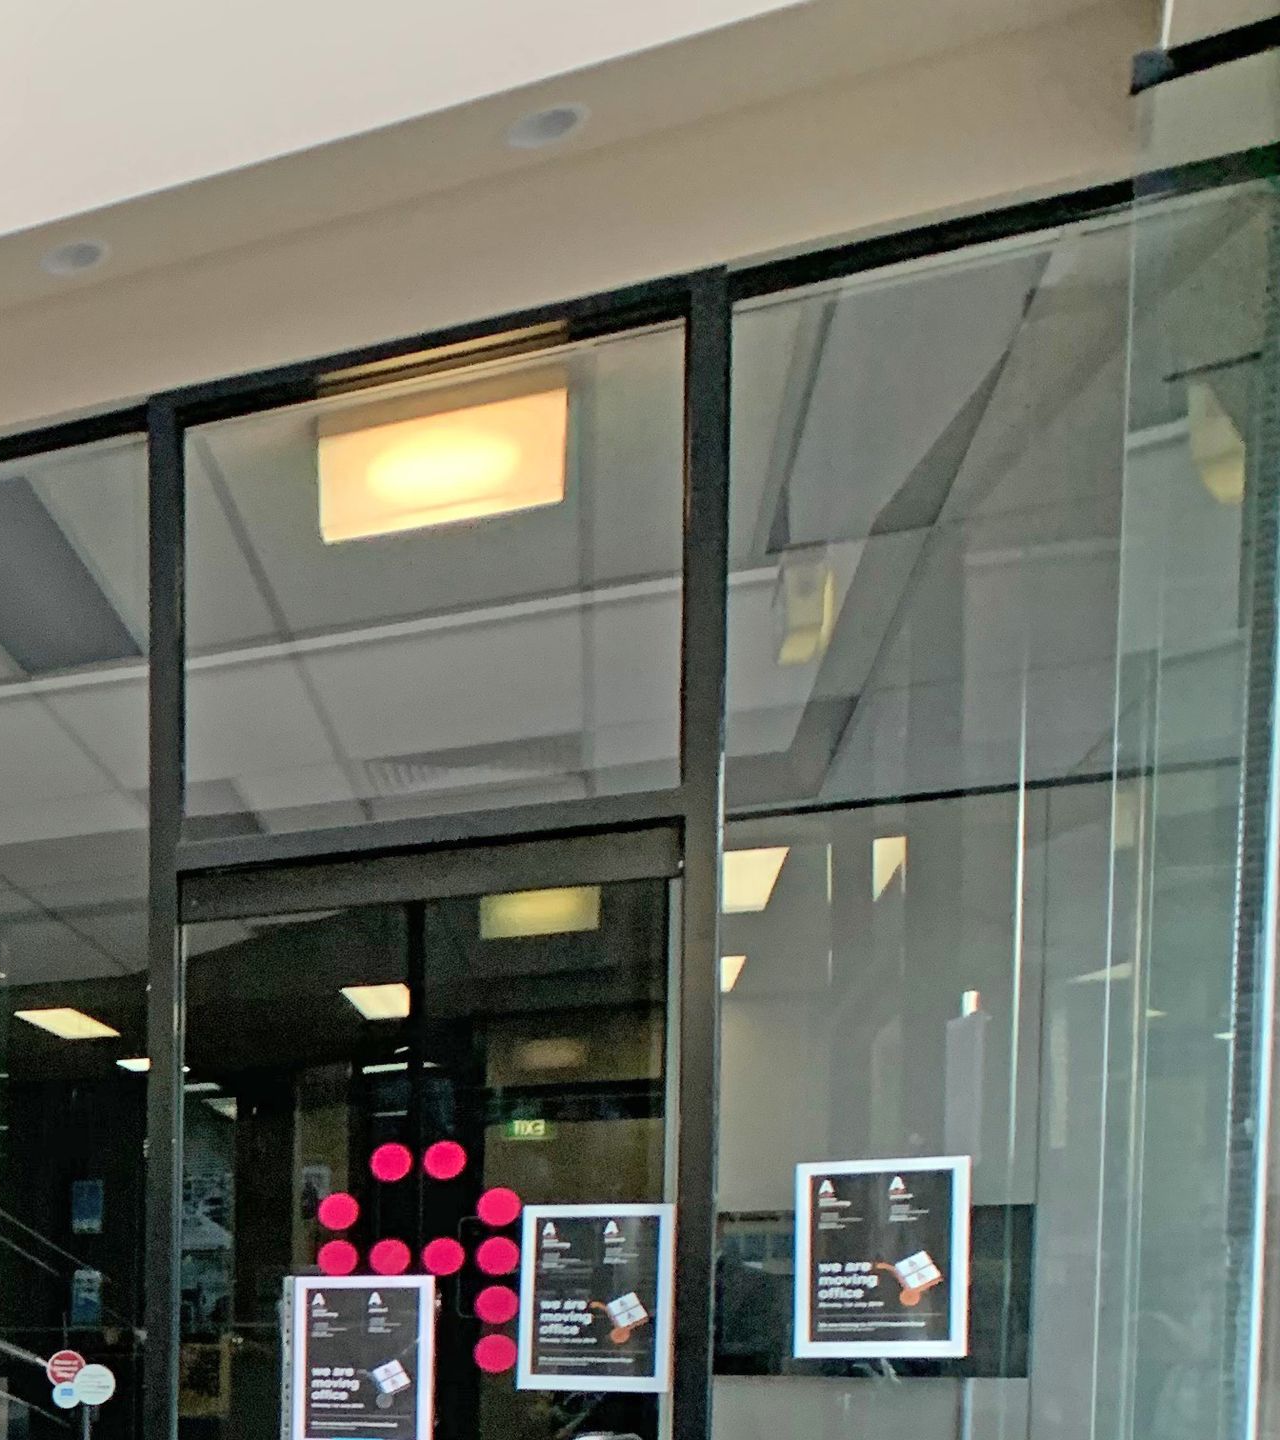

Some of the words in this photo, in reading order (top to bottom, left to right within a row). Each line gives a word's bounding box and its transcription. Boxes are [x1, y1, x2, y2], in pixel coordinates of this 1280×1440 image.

[818, 1262, 842, 1273] we
[844, 1261, 872, 1273] are
[818, 1274, 879, 1289] moving
[817, 1287, 865, 1300] office
[539, 1300, 562, 1311] we
[563, 1300, 587, 1311] are
[539, 1312, 593, 1325] moving
[539, 1323, 580, 1336] office
[311, 1367, 331, 1377] we
[332, 1367, 354, 1377] are
[311, 1378, 360, 1391] moving
[311, 1389, 349, 1400] office
